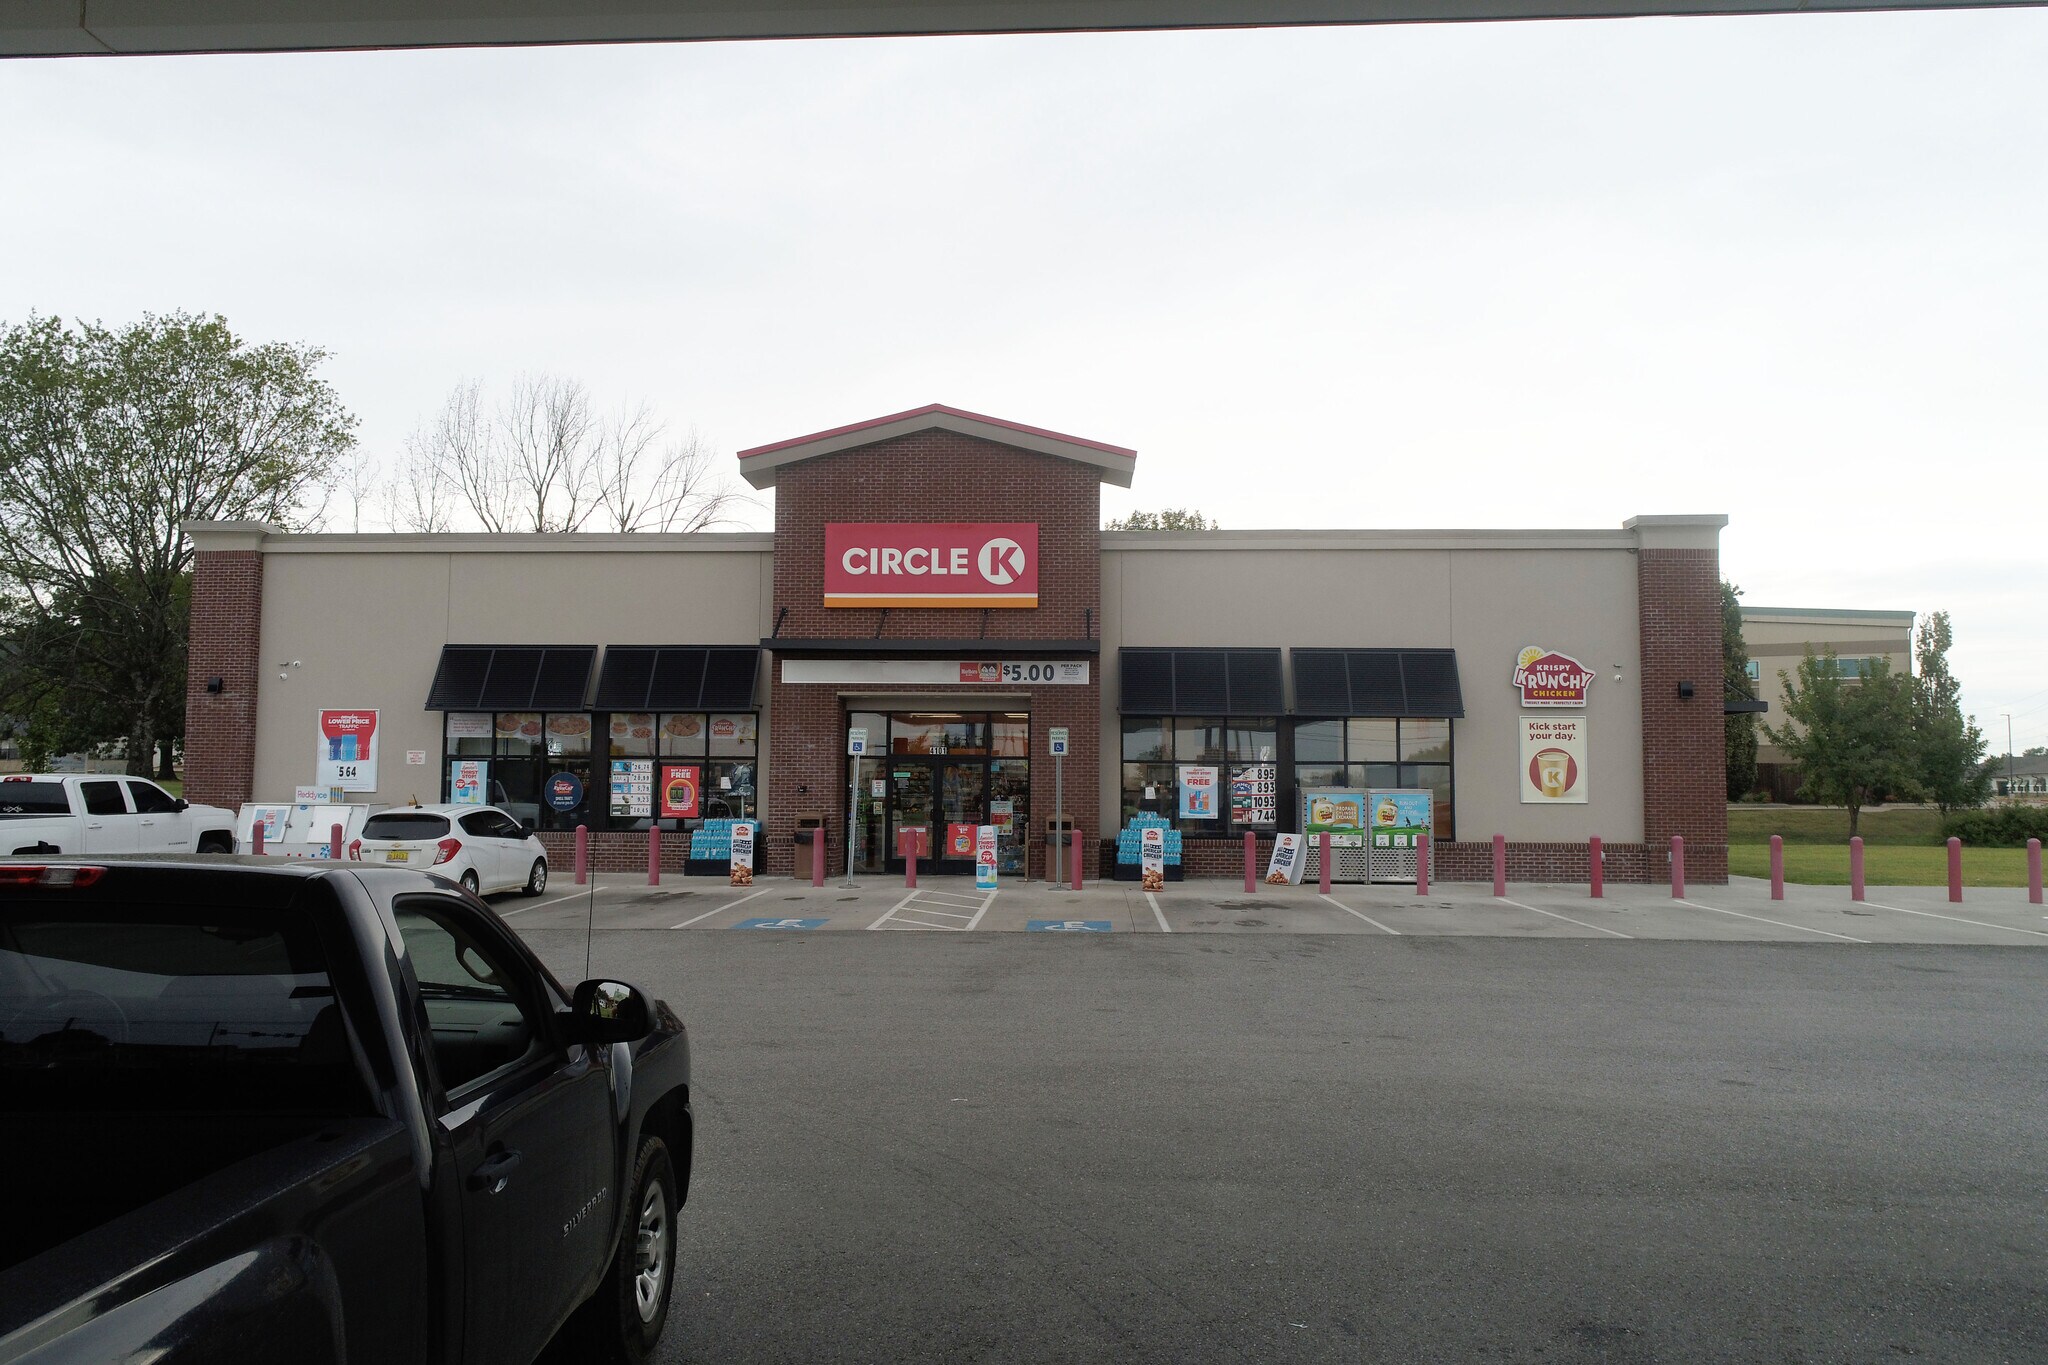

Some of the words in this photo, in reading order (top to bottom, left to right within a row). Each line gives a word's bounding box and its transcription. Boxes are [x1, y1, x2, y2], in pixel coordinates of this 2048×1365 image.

[842, 547, 969, 575] CIRCLE
[988, 545, 1021, 582] K
[1003, 664, 1055, 681] $5.00
[1517, 670, 1592, 689] KRUNCHY
[1529, 733, 1552, 741] your
[1555, 732, 1576, 741] day.
[1273, 859, 1291, 867] CHICKEN
[563, 1187, 607, 1238] SILVERADO
